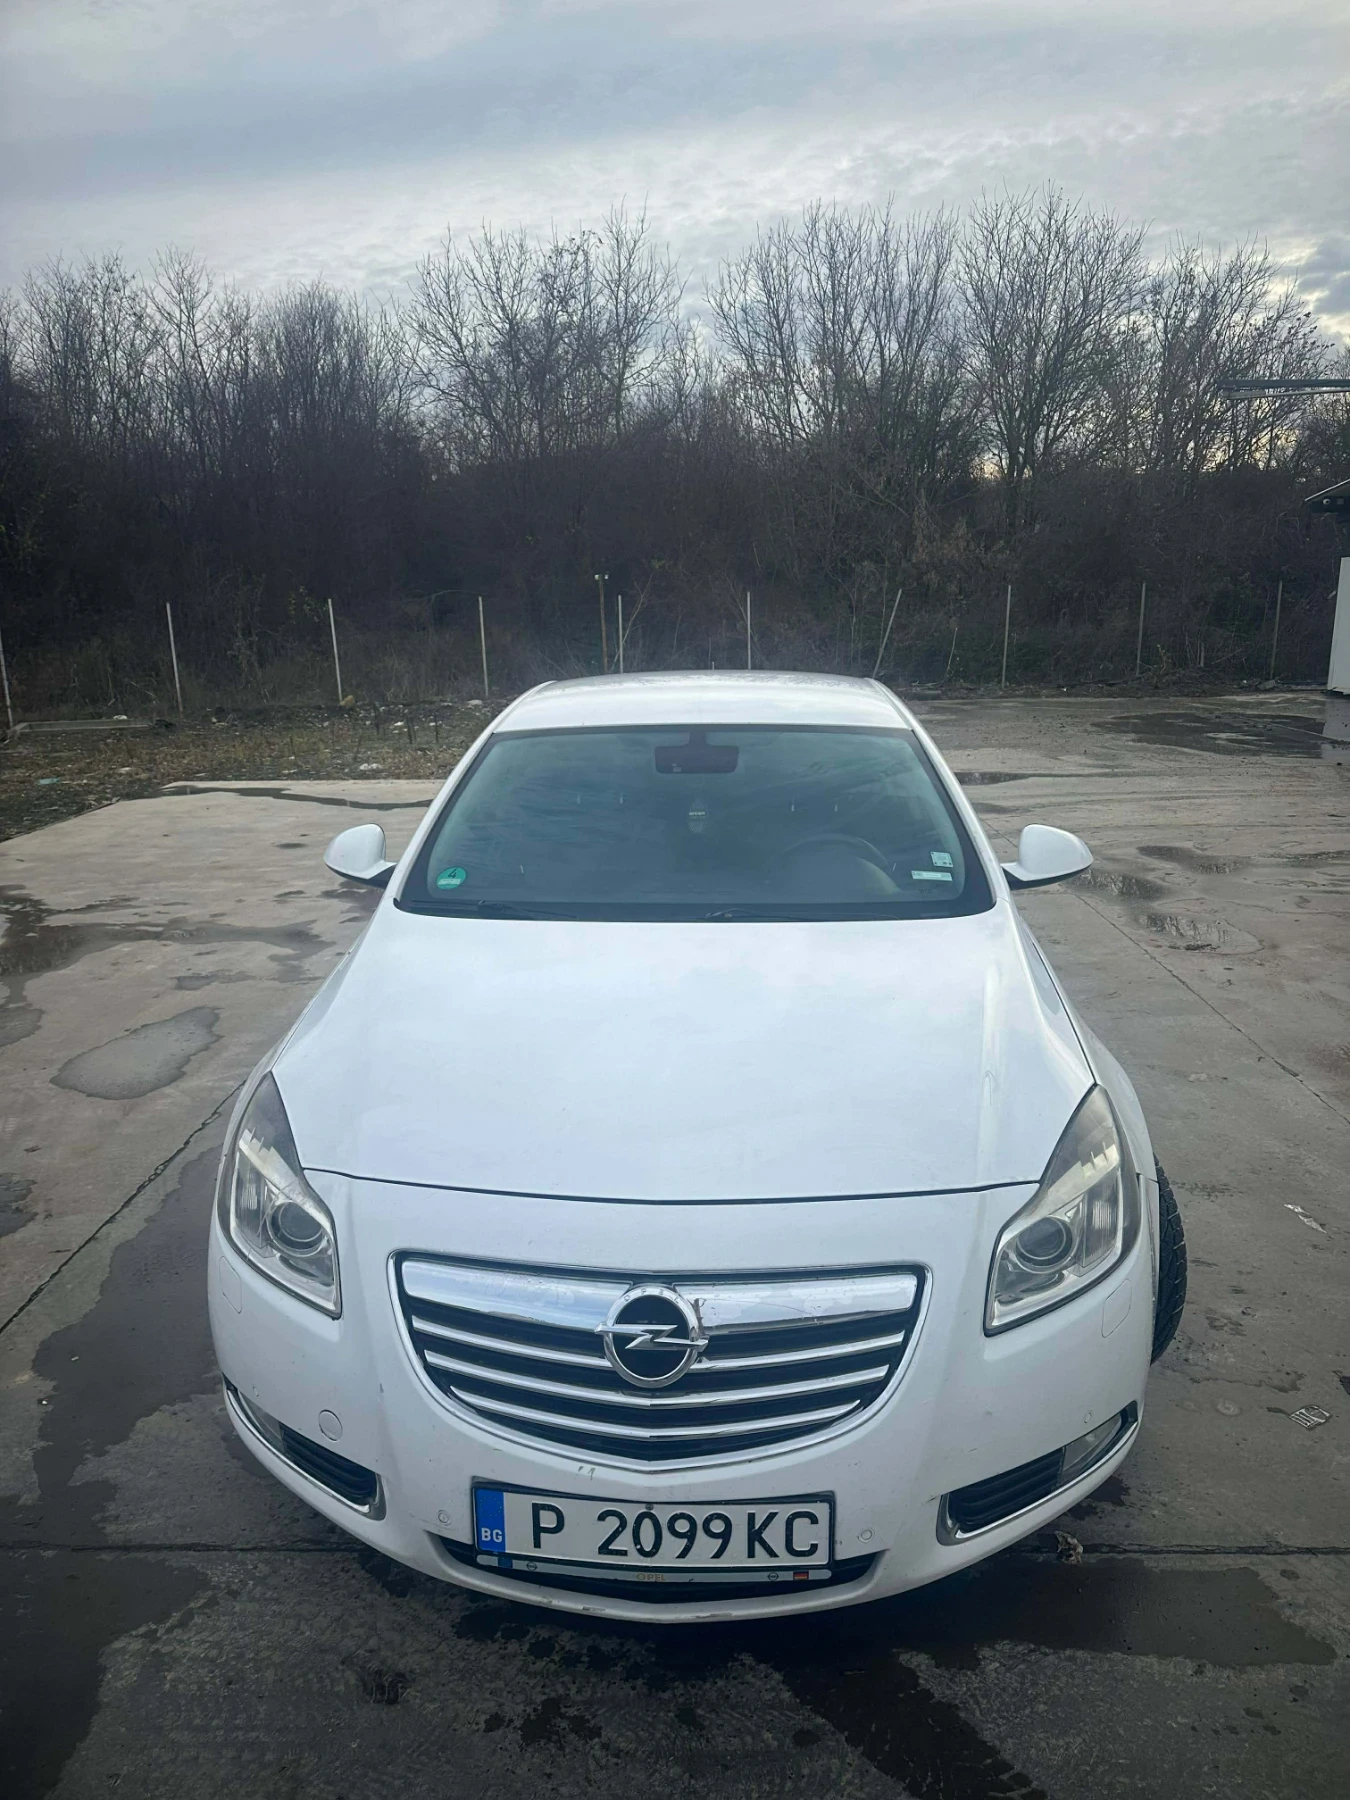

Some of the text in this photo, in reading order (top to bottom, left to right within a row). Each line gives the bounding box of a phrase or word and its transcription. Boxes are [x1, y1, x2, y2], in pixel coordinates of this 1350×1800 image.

[447, 868, 458, 879] 4
[481, 1527, 503, 1543] BG
[531, 1502, 819, 1559] P 2099 KC
